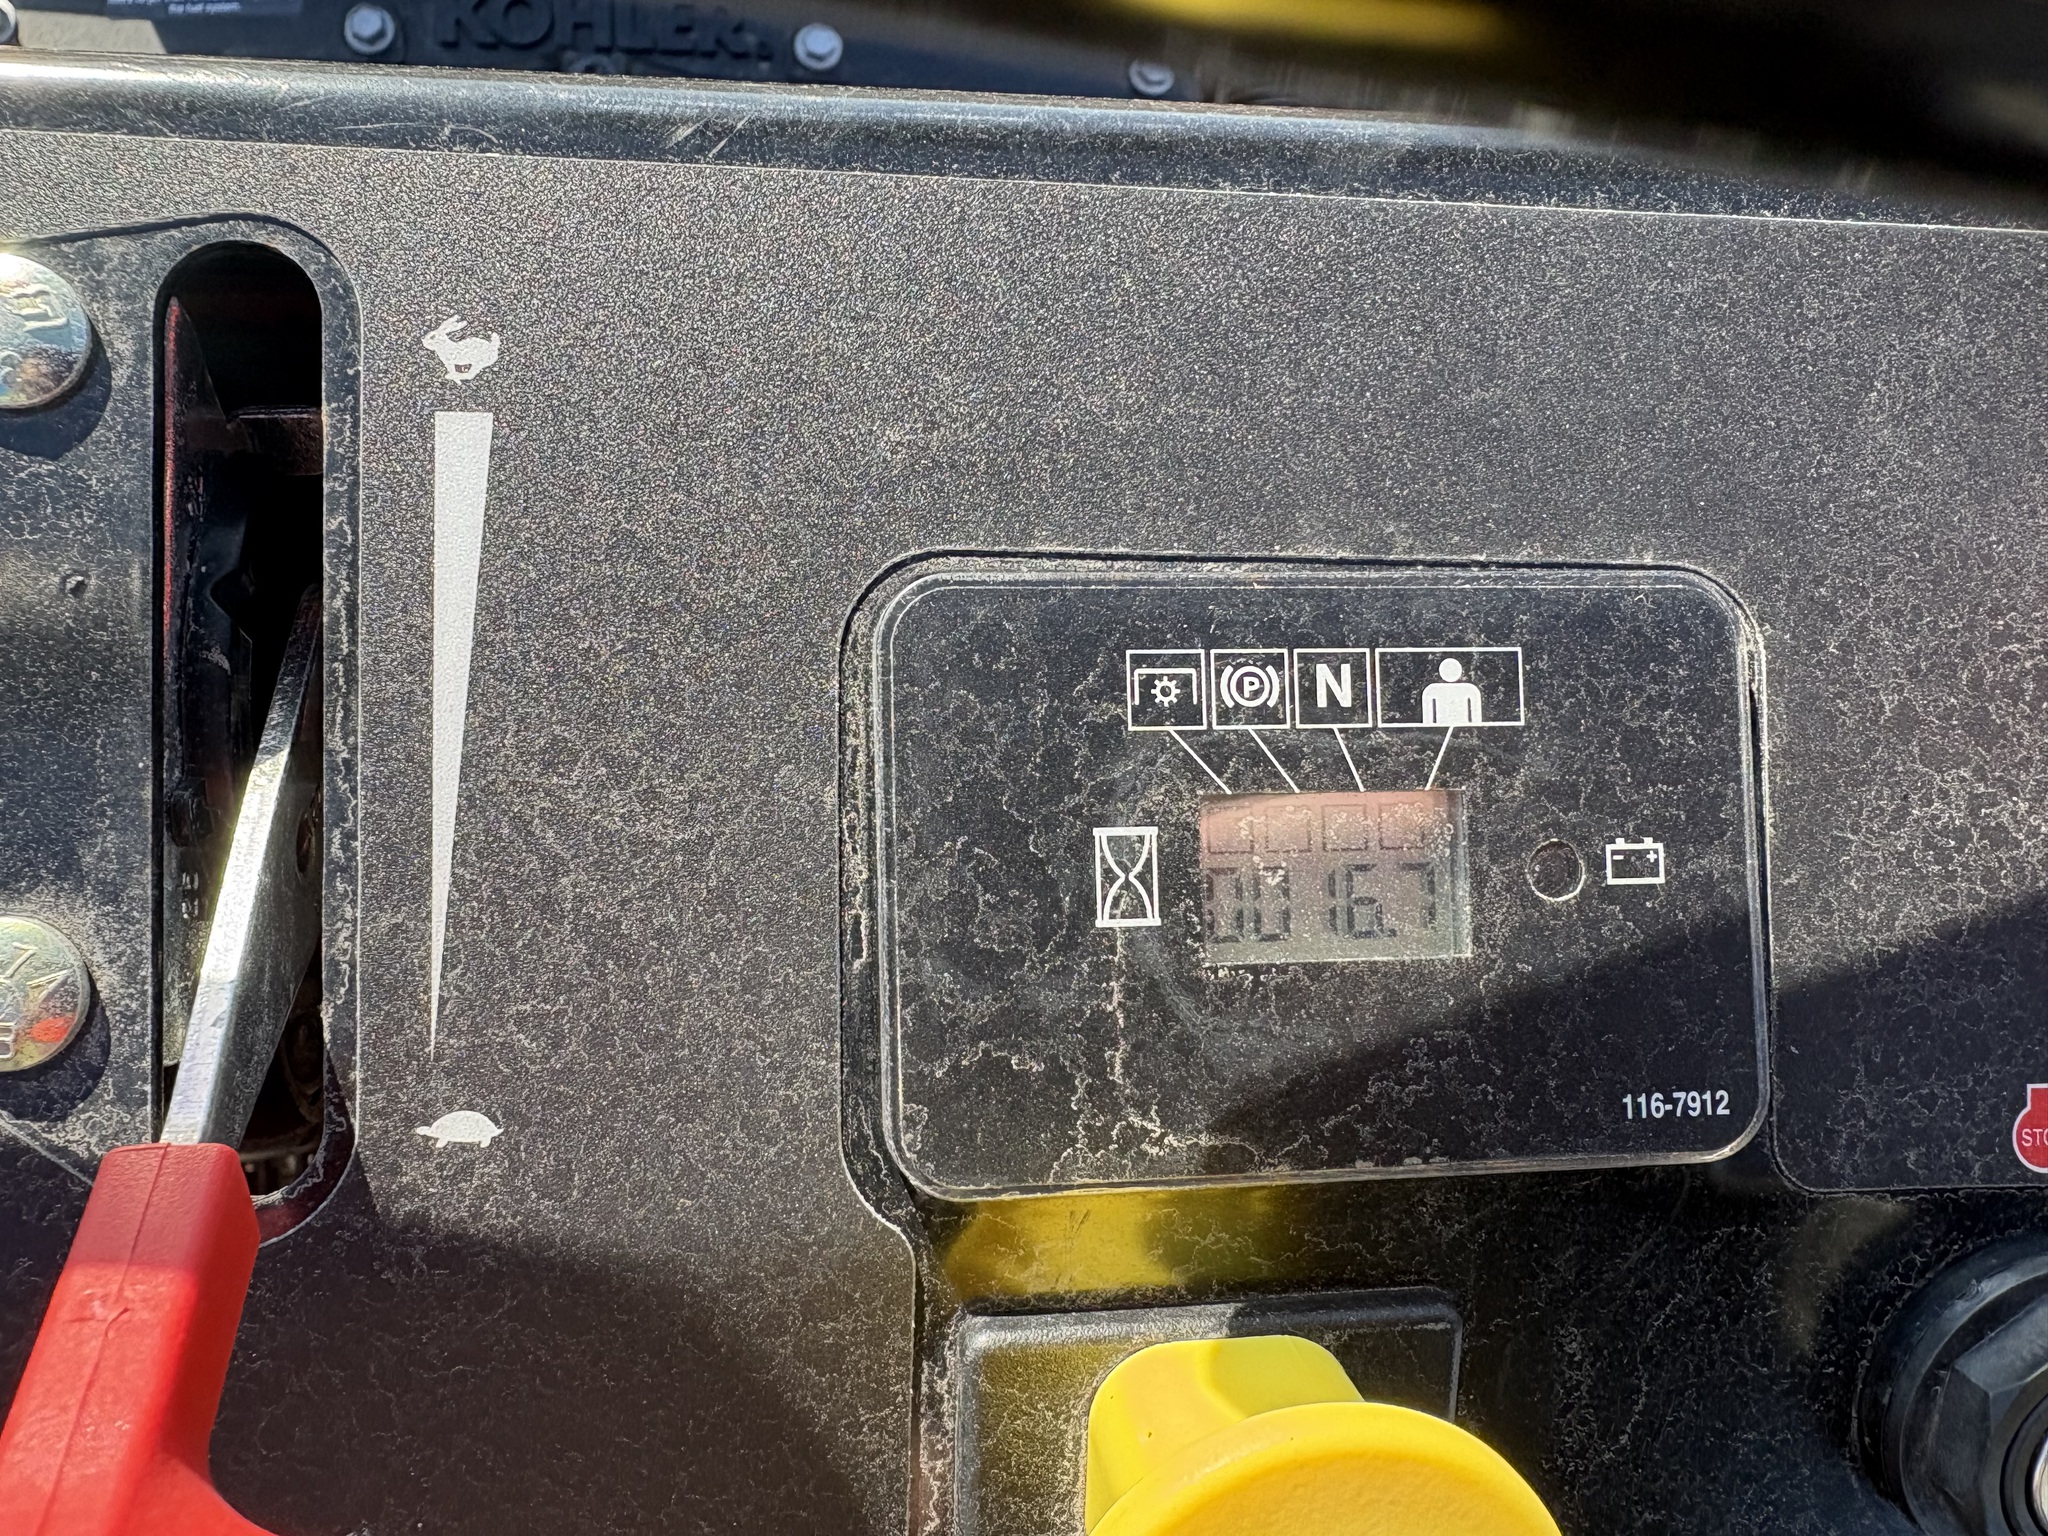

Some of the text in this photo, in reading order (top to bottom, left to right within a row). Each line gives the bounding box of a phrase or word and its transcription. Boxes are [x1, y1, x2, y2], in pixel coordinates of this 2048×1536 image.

[1243, 679, 1259, 698] P
[1315, 663, 1352, 708] N
[1622, 1090, 1731, 1120] 116-7912
